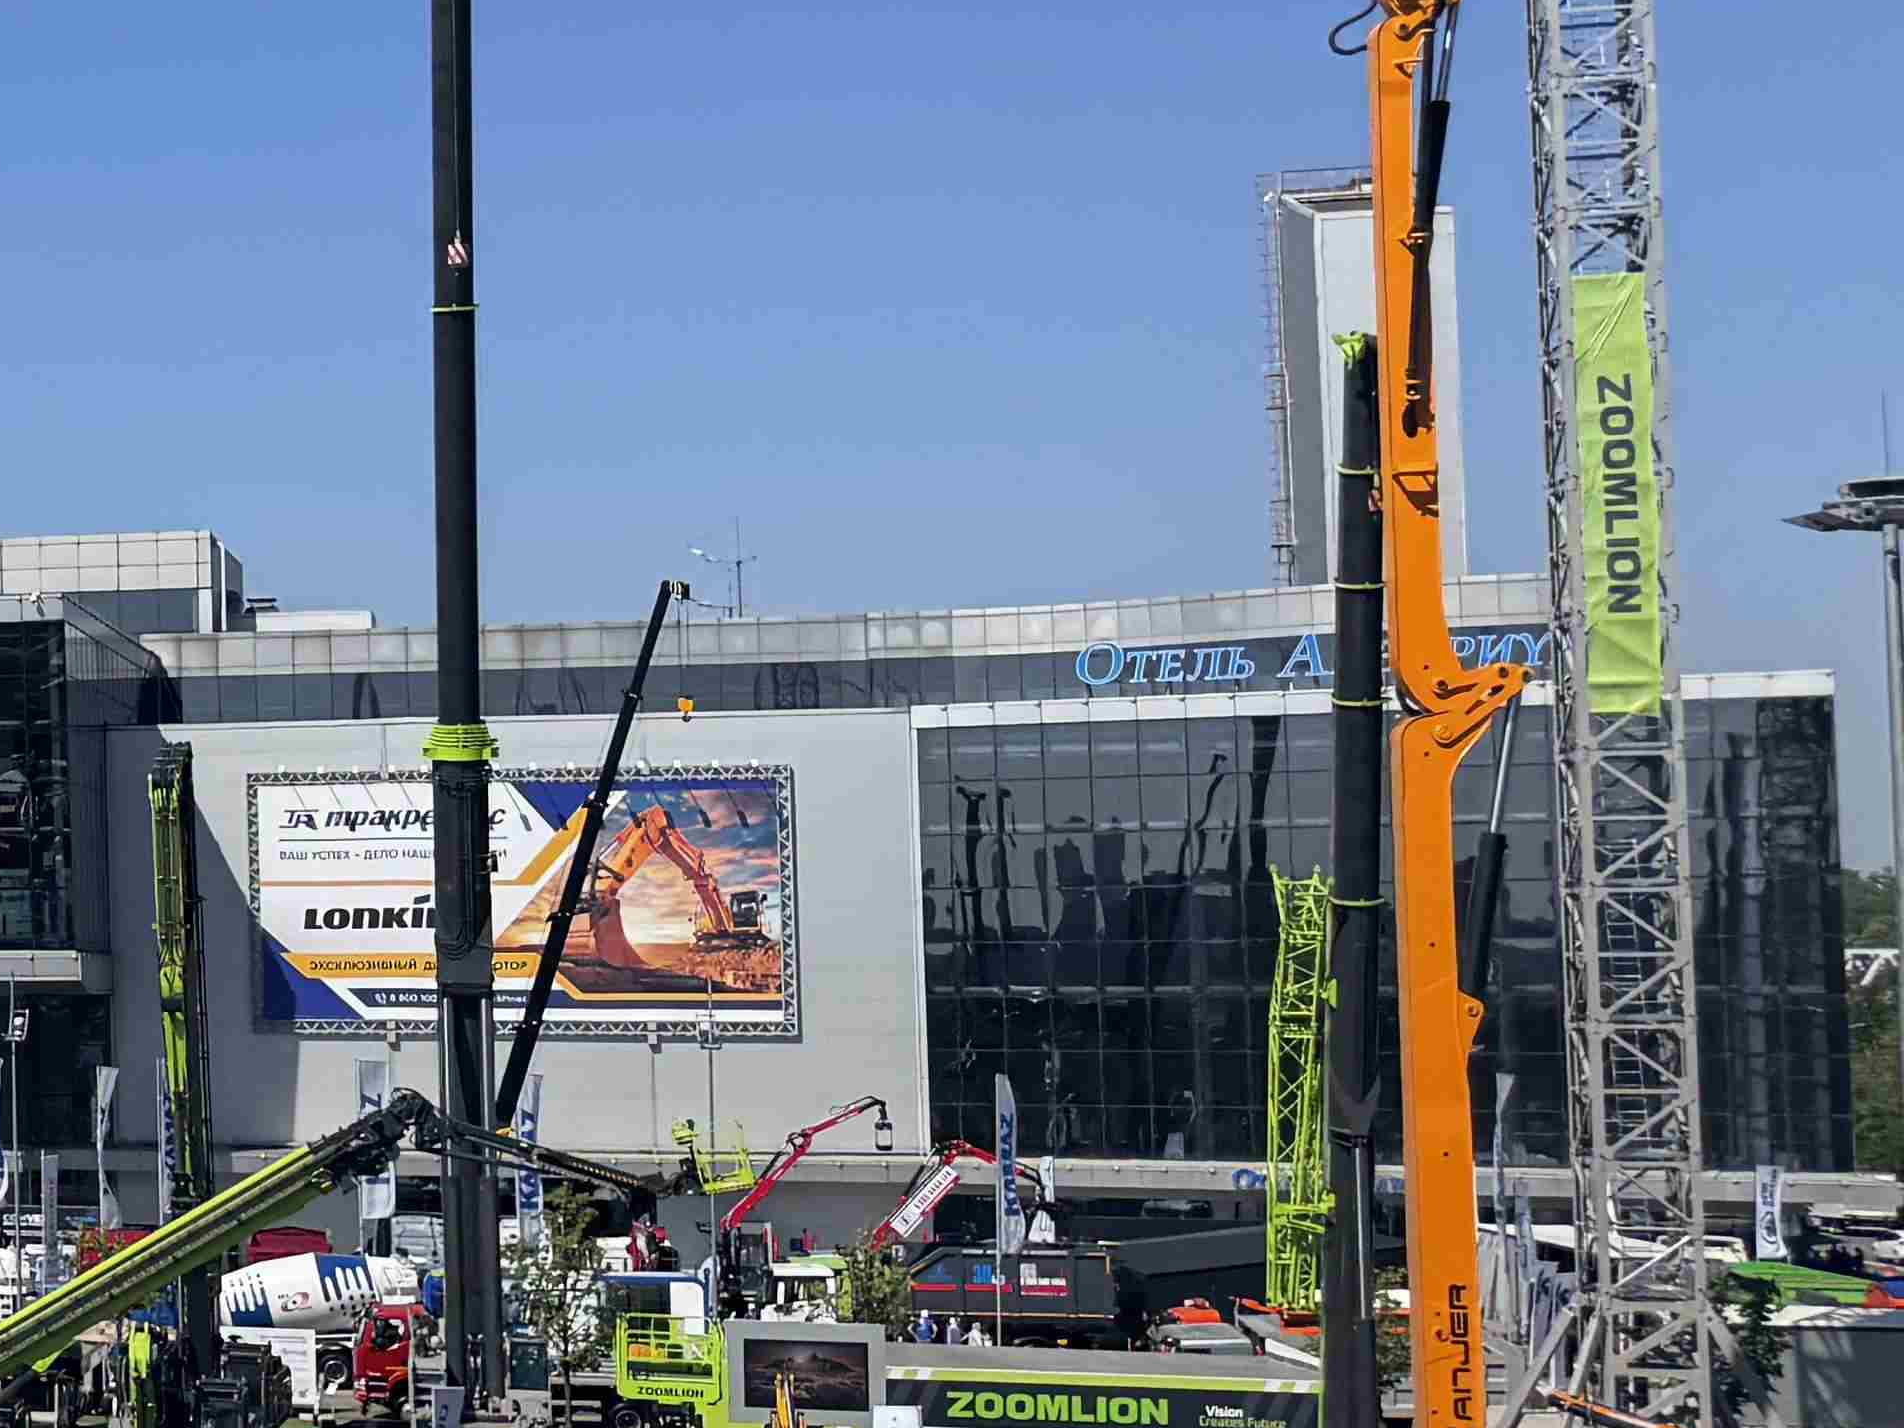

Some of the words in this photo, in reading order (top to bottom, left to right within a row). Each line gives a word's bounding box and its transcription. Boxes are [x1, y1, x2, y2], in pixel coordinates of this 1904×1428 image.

[1594, 373, 1642, 615] ZOOMLION
[280, 851, 308, 861] ВАШ
[312, 850, 350, 861] УСПЕХ
[364, 849, 398, 861] ДЕЛО
[520, 1109, 539, 1213] KAAZ
[1001, 1113, 1021, 1217] KAMAZ
[637, 1386, 705, 1399] ZOOMLION
[946, 1391, 1169, 1426] ZOOMLION
[1205, 1404, 1244, 1418] Vision
